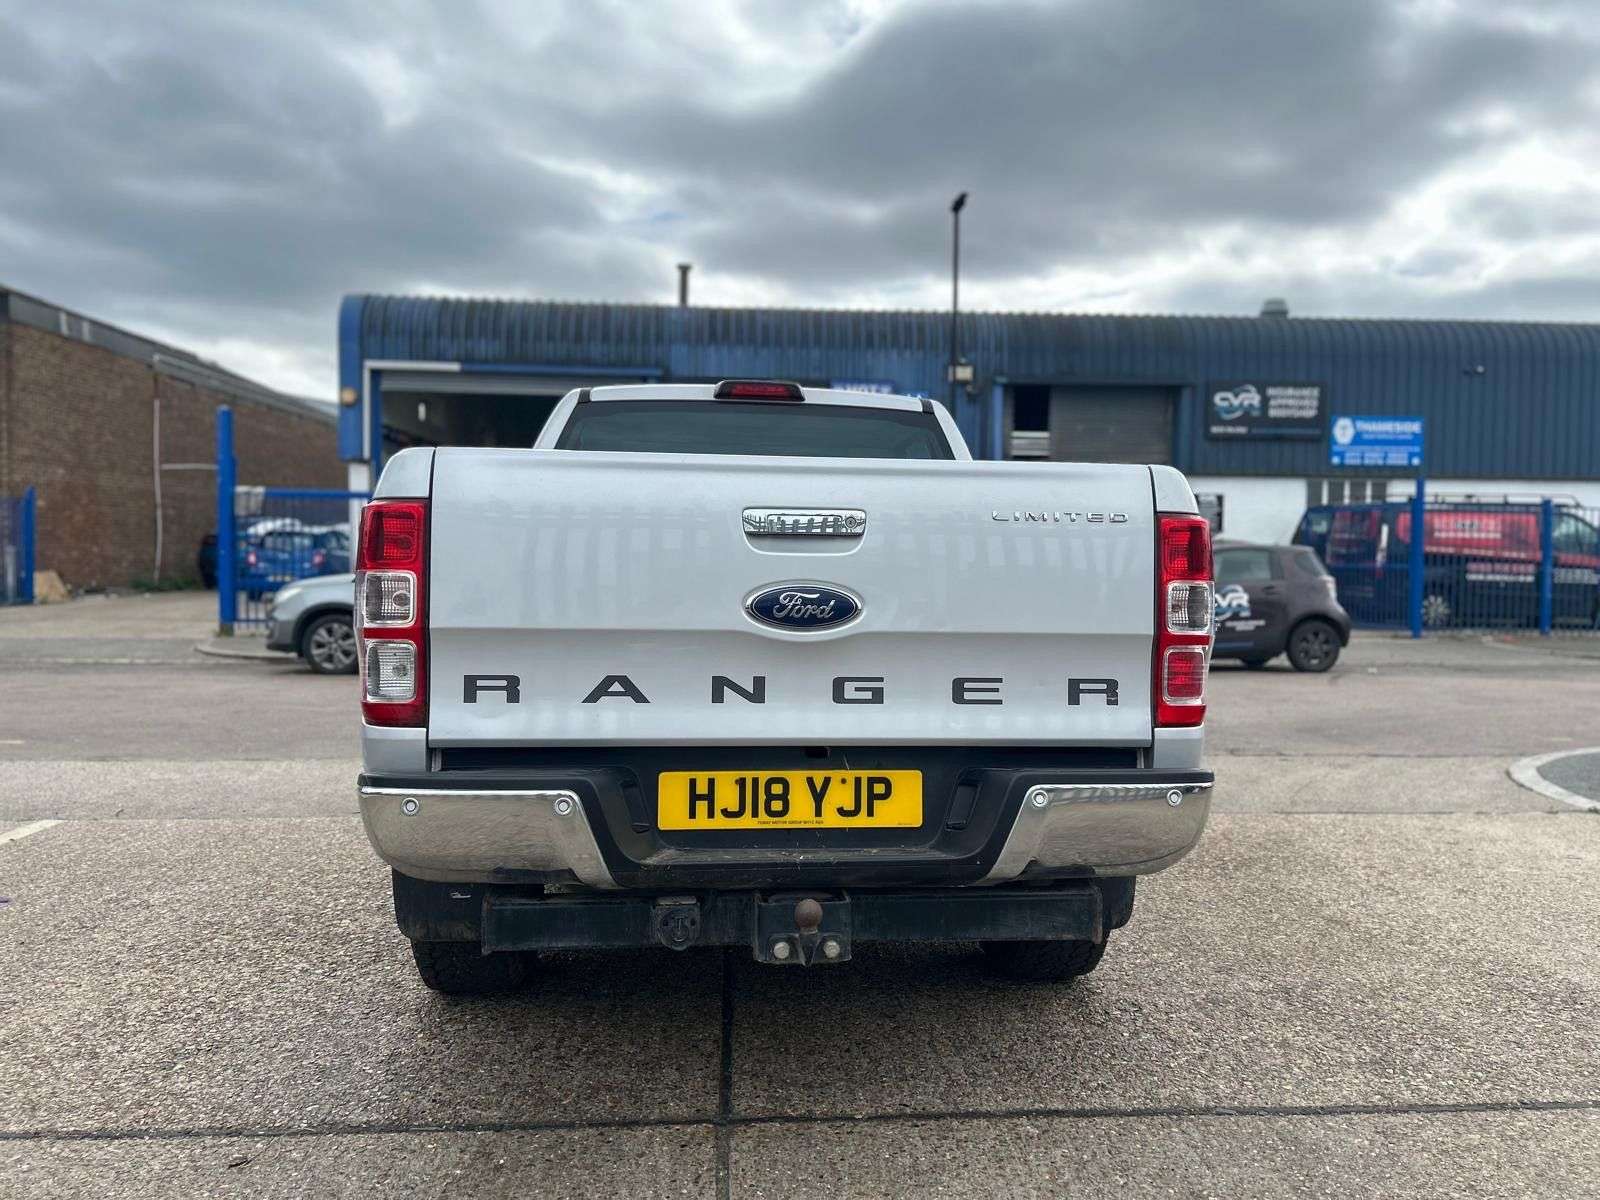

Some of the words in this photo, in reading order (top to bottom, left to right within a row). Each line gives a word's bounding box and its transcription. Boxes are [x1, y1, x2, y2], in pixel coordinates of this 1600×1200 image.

[991, 510, 1129, 524] LIMITED
[772, 591, 835, 621] Ford
[463, 674, 1119, 706] RANGER
[688, 776, 790, 820] HJ18
[806, 776, 893, 818] YJP
